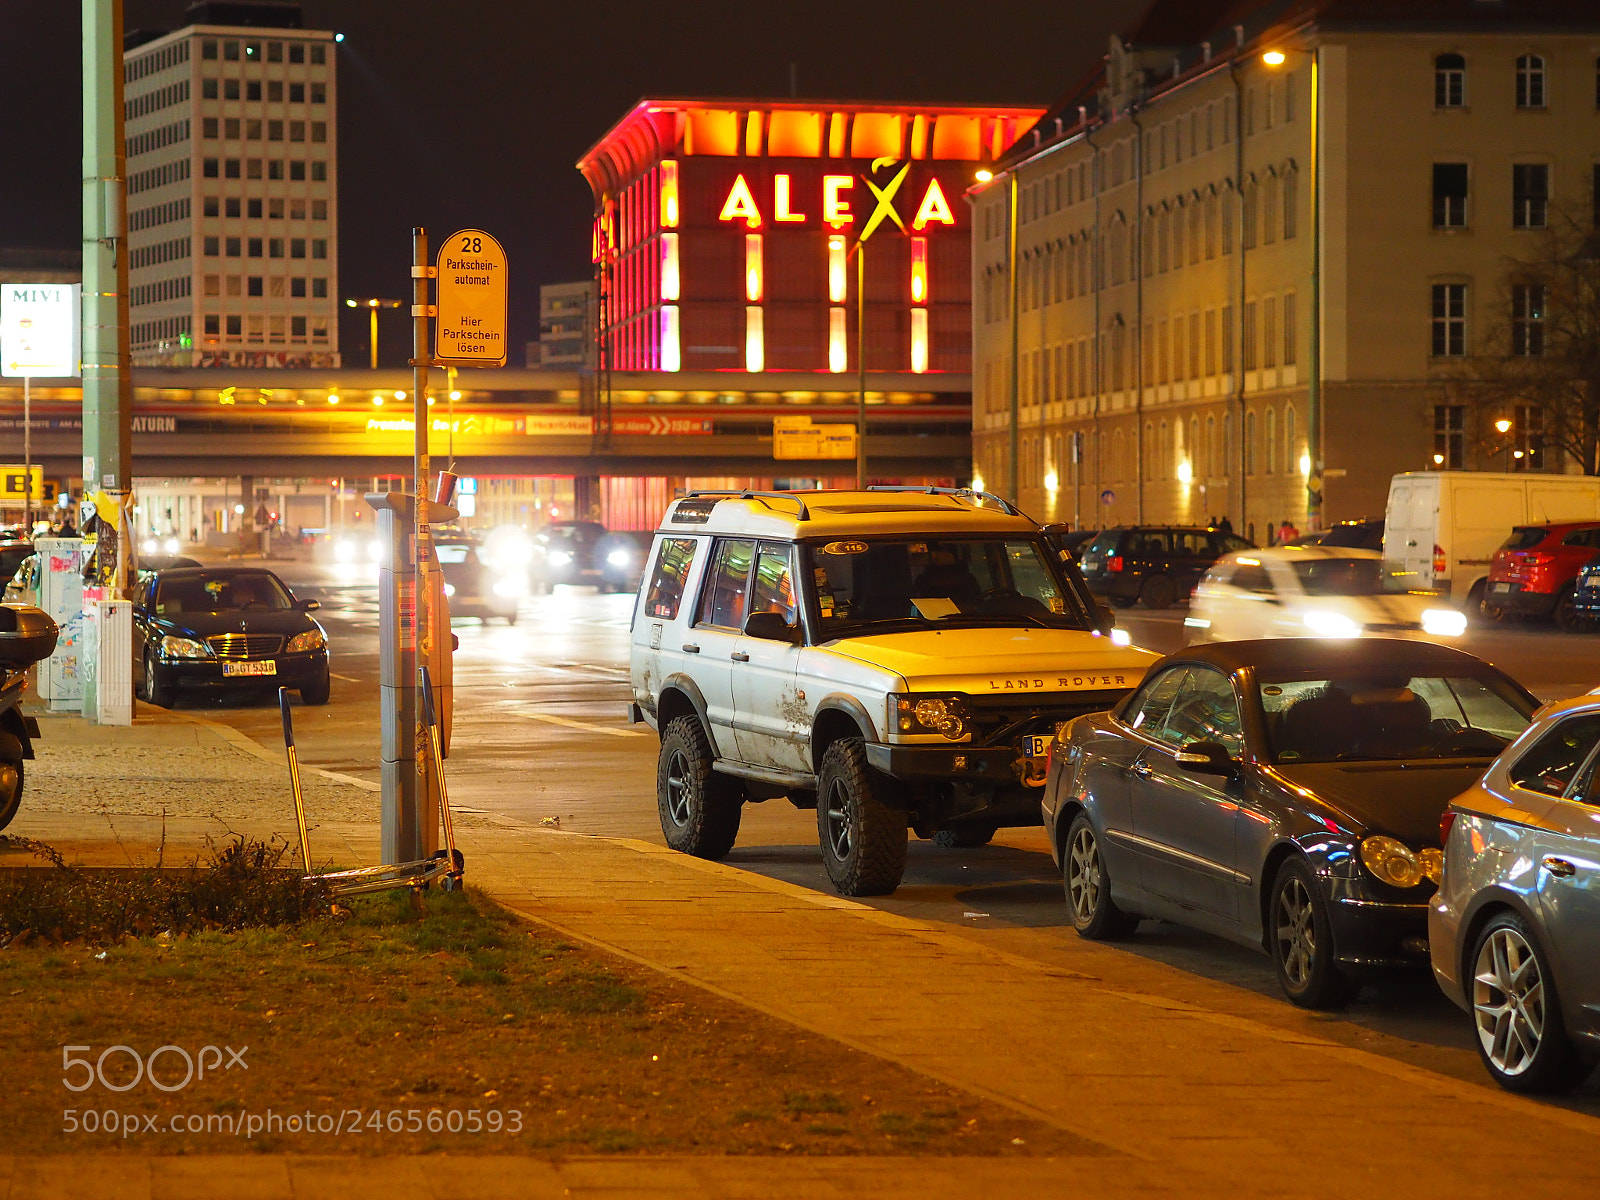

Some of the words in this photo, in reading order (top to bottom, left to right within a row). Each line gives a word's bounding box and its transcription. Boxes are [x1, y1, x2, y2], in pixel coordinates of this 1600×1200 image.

[718, 157, 956, 241] ALEXA
[461, 237, 482, 253] 28
[446, 258, 499, 271] Parkschein-
[454, 275, 490, 286] automat
[13, 289, 60, 302] MIVI
[460, 316, 482, 327] Hier
[443, 328, 500, 340] Parkschein
[457, 342, 486, 353] lösen
[131, 416, 176, 432] ATURN
[989, 679, 1044, 690] LAND
[1057, 675, 1126, 687] ROVER
[1034, 738, 1044, 755] B
